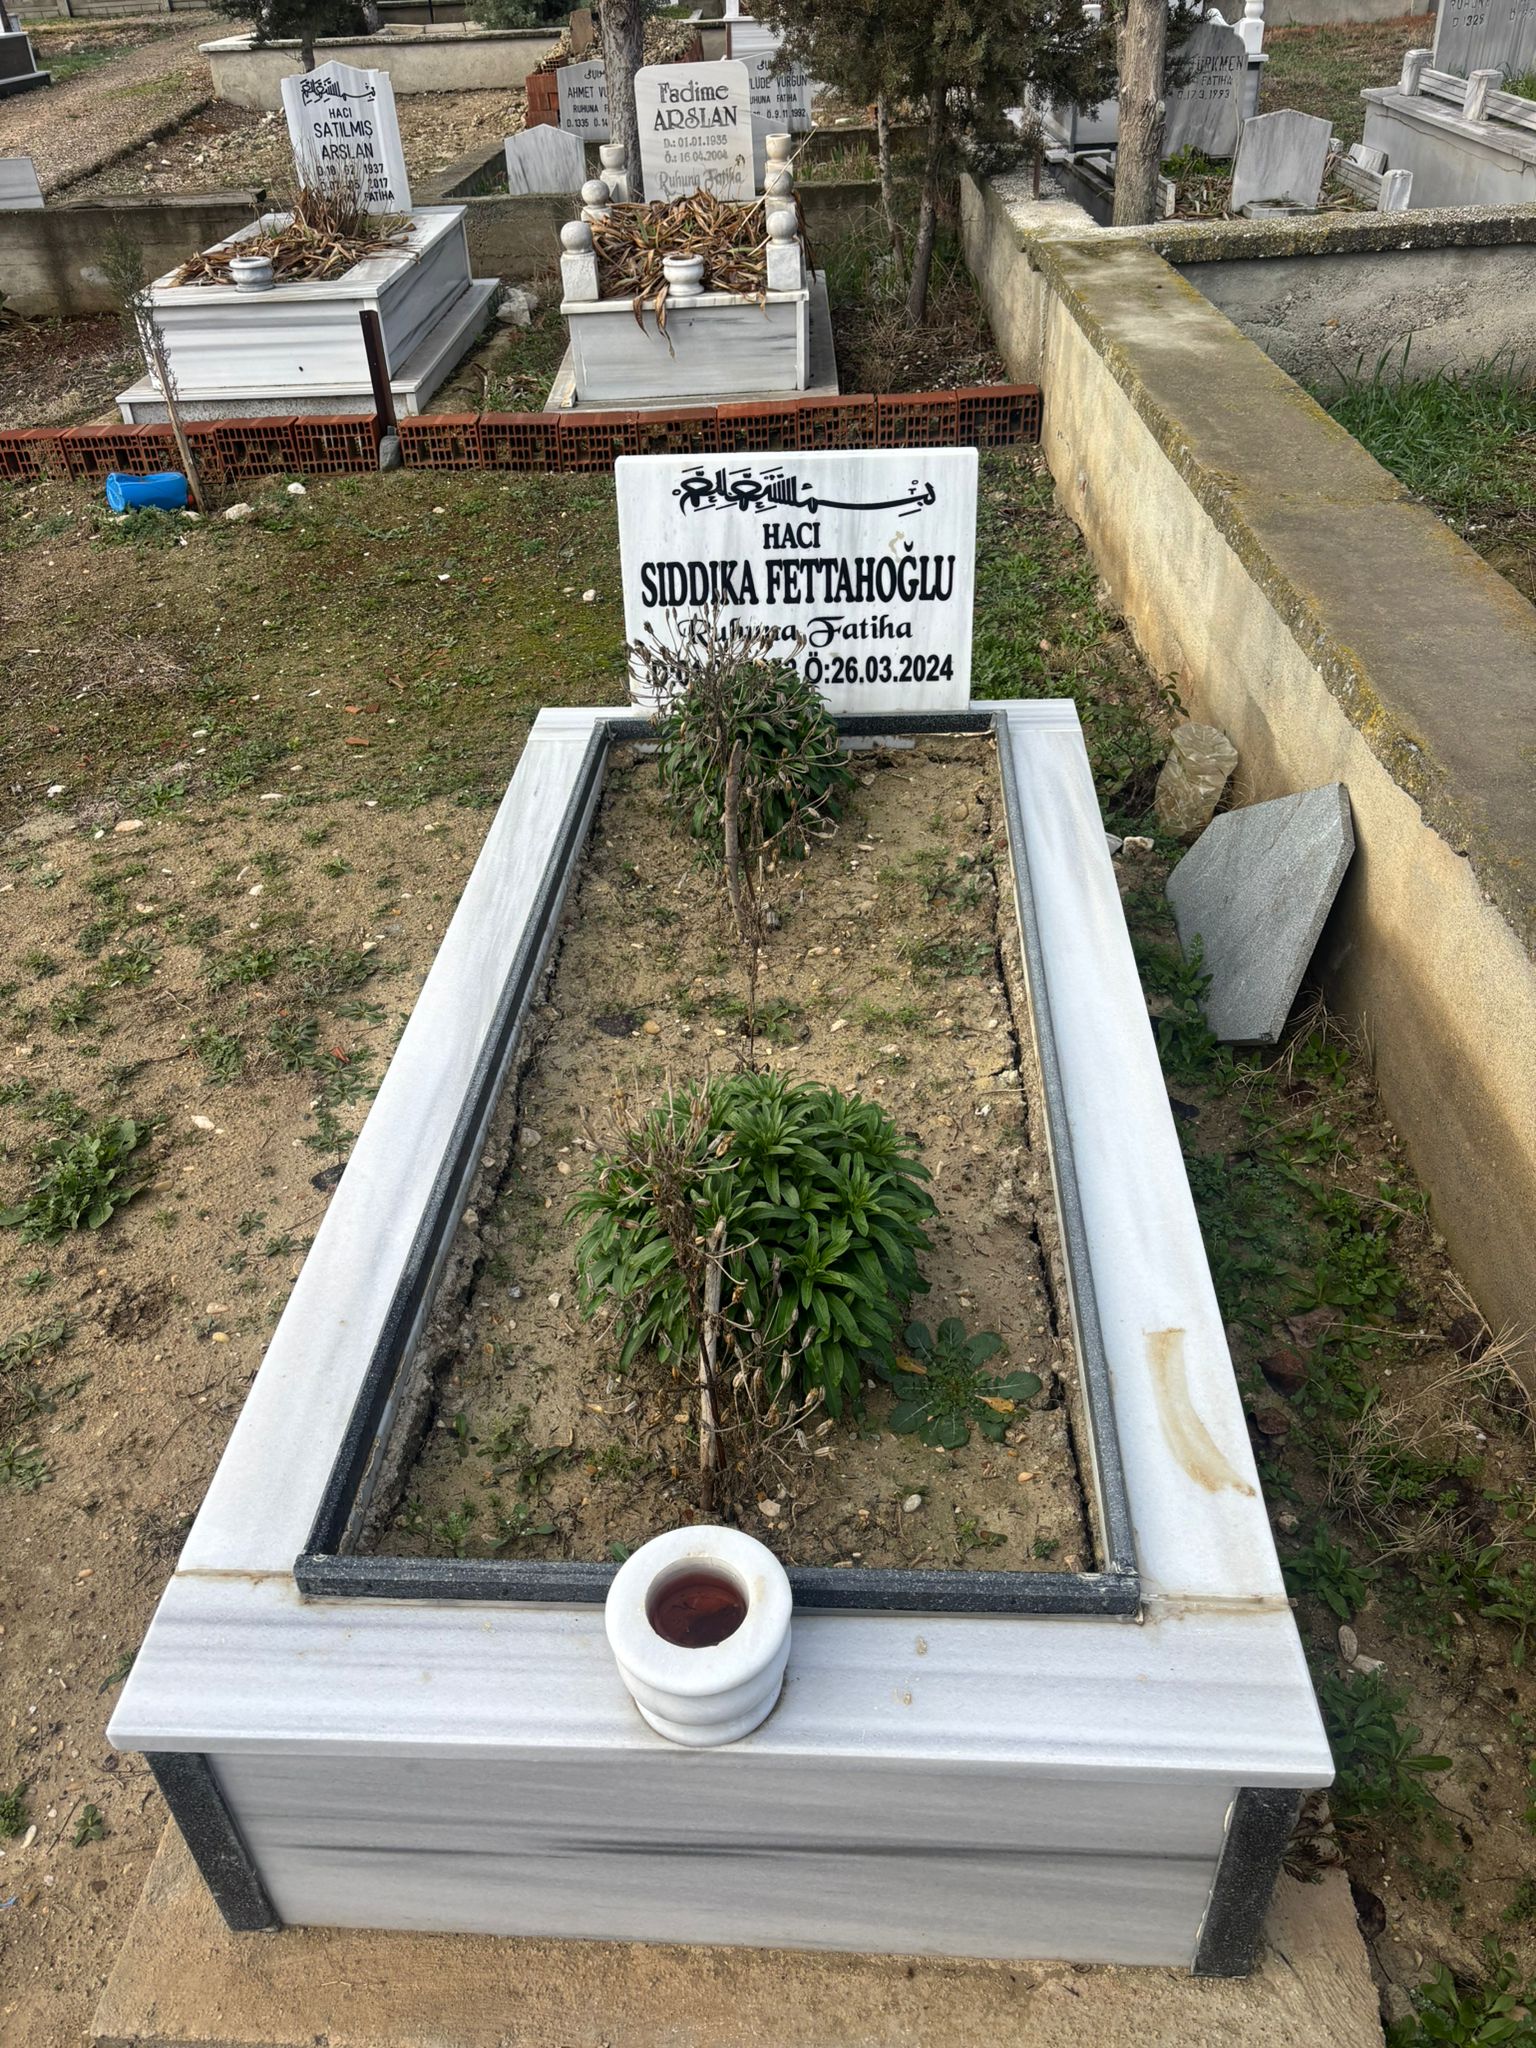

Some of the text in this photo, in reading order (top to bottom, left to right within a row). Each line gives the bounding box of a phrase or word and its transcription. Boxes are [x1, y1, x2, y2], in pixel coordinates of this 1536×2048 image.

[749, 73, 808, 90] LUDE VURGUN
[567, 85, 595, 98] AHMET
[657, 79, 729, 103] Fadime
[572, 103, 599, 114] RUHUNA
[750, 95, 771, 106] UHUNA
[329, 107, 352, 119] HACI
[653, 105, 738, 131] ARSLAN
[314, 120, 374, 139] SATILMIŞ
[567, 117, 590, 128] D.1335
[322, 143, 375, 160] ARSLAN
[367, 177, 389, 189] 2017
[763, 522, 821, 549] HACI
[641, 540, 956, 607] SIDDIKA FETTAHOĞLU
[807, 614, 914, 648] Fatiha
[804, 651, 954, 684] Ö:26.03.2024
